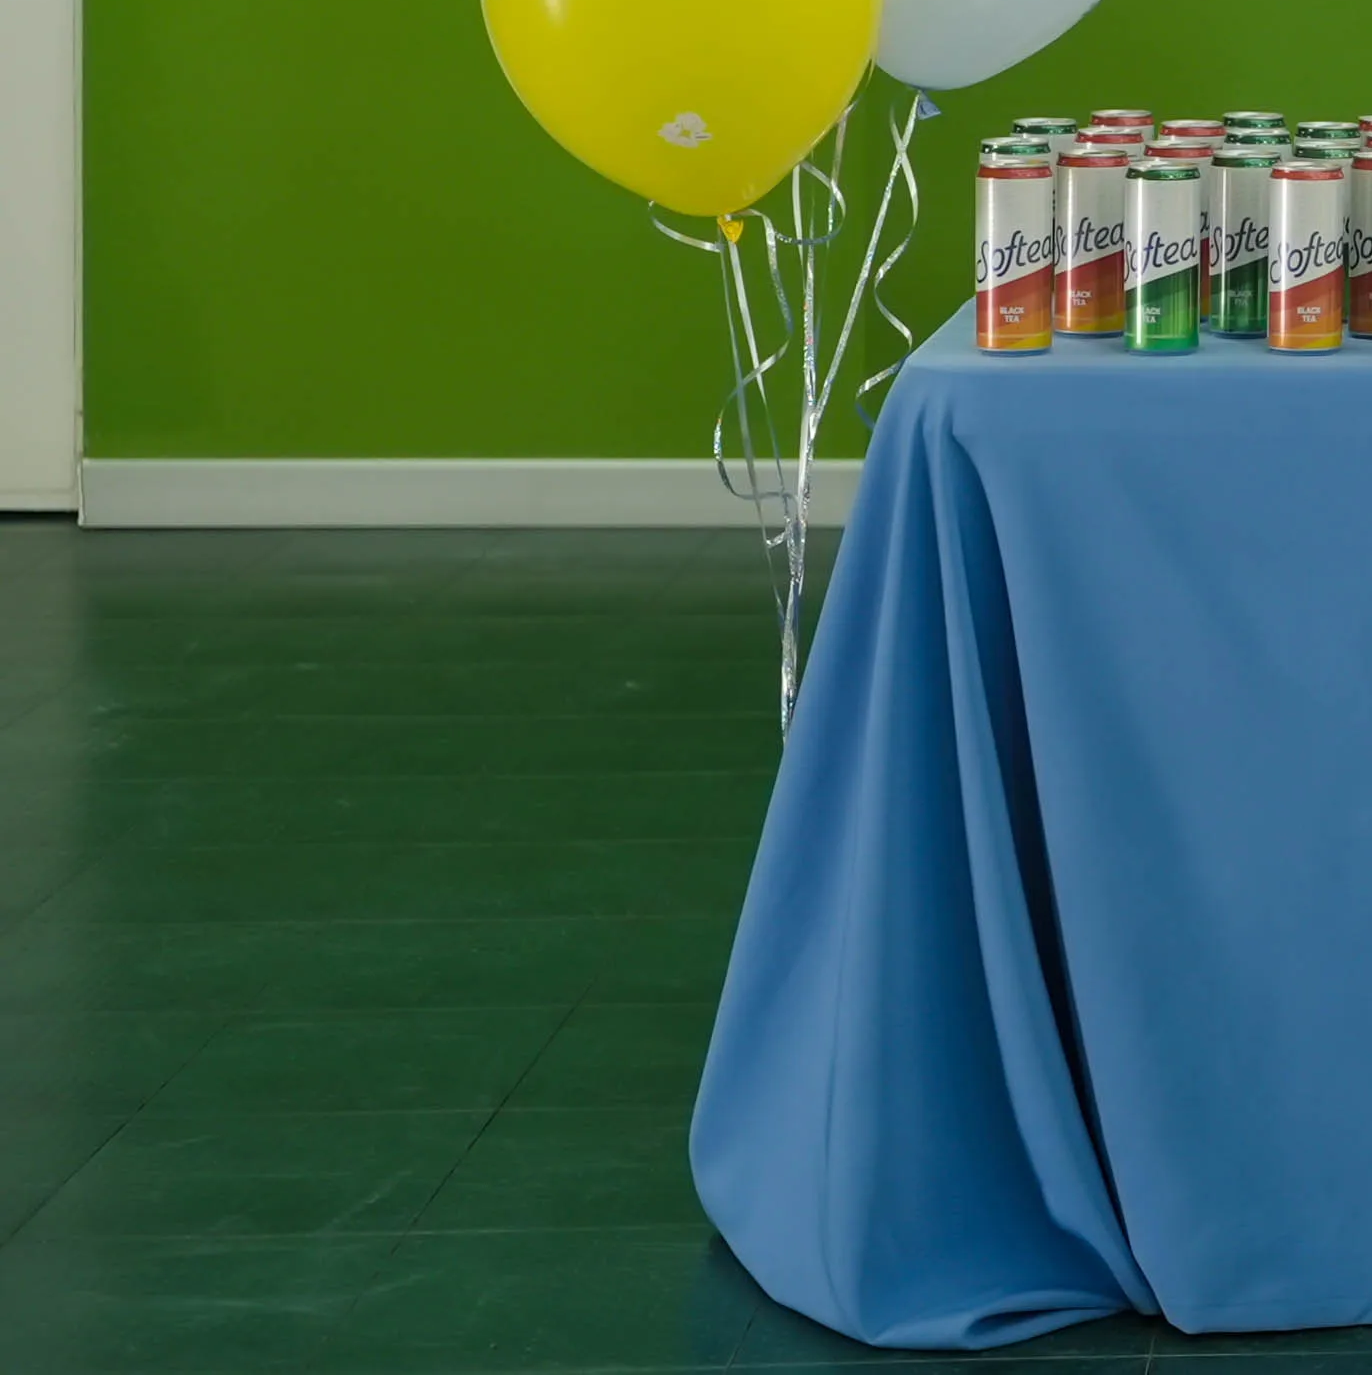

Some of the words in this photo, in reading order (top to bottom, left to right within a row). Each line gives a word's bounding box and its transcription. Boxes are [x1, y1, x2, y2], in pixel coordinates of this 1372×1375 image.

[1209, 217, 1269, 267] Softe
[1000, 306, 1025, 315] BLACK
[1297, 306, 1321, 315] BLACK
[1005, 314, 1021, 323] TEA
[1302, 315, 1317, 323] TEA
